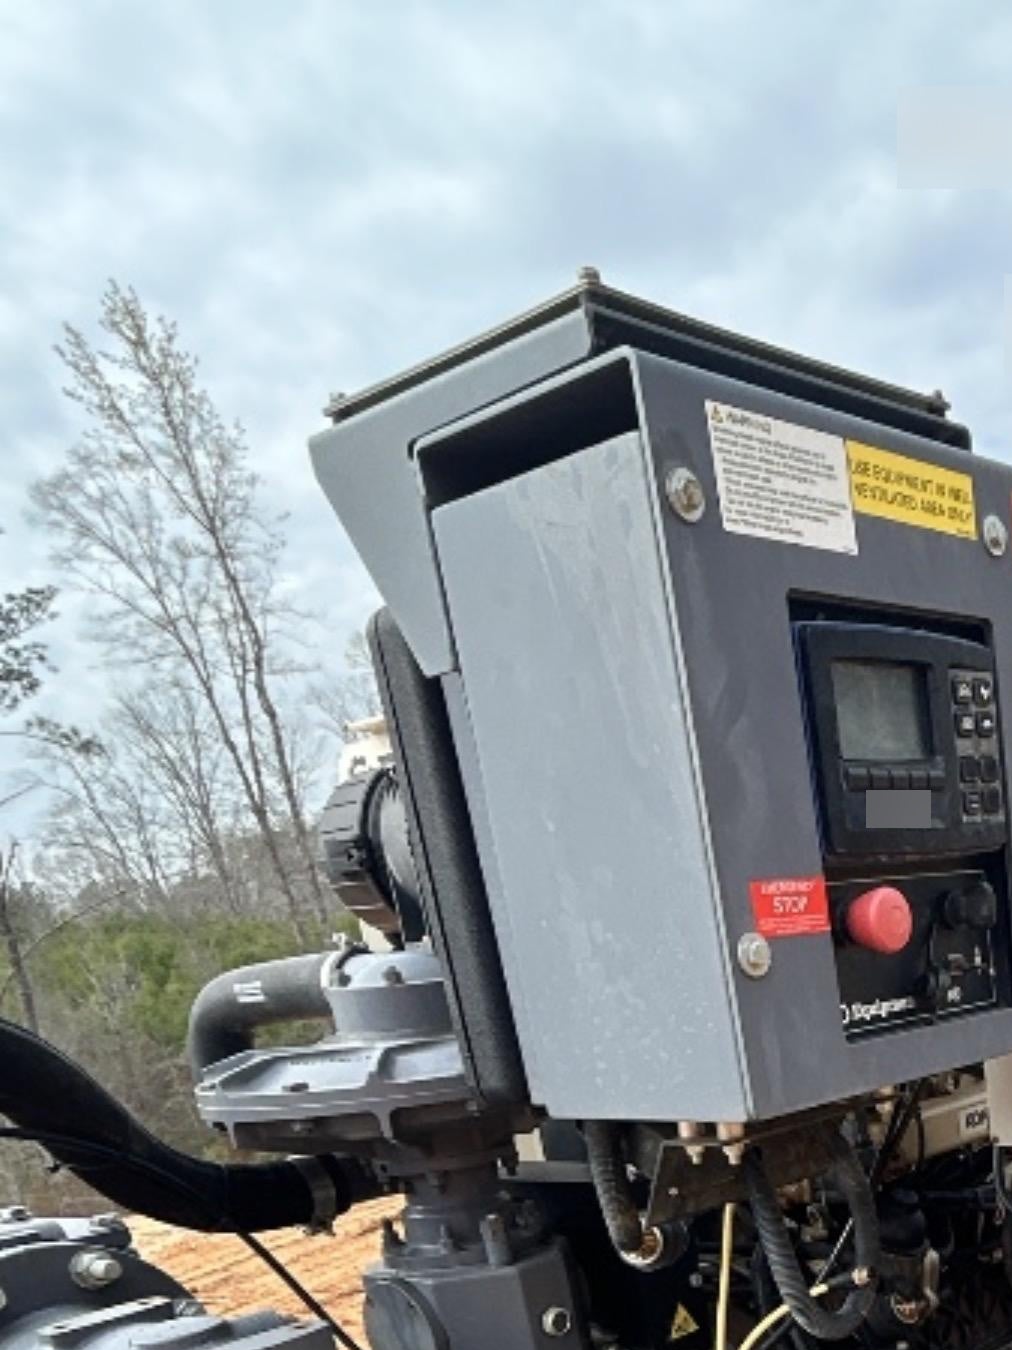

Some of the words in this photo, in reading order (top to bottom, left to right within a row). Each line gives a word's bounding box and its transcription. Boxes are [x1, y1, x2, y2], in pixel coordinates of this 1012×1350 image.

[872, 463, 934, 494] EQUIPMENT
[854, 482, 918, 511] VENTILATED
[920, 497, 945, 517] AREA
[947, 506, 972, 522] ONLY
[773, 895, 808, 914] STOP
